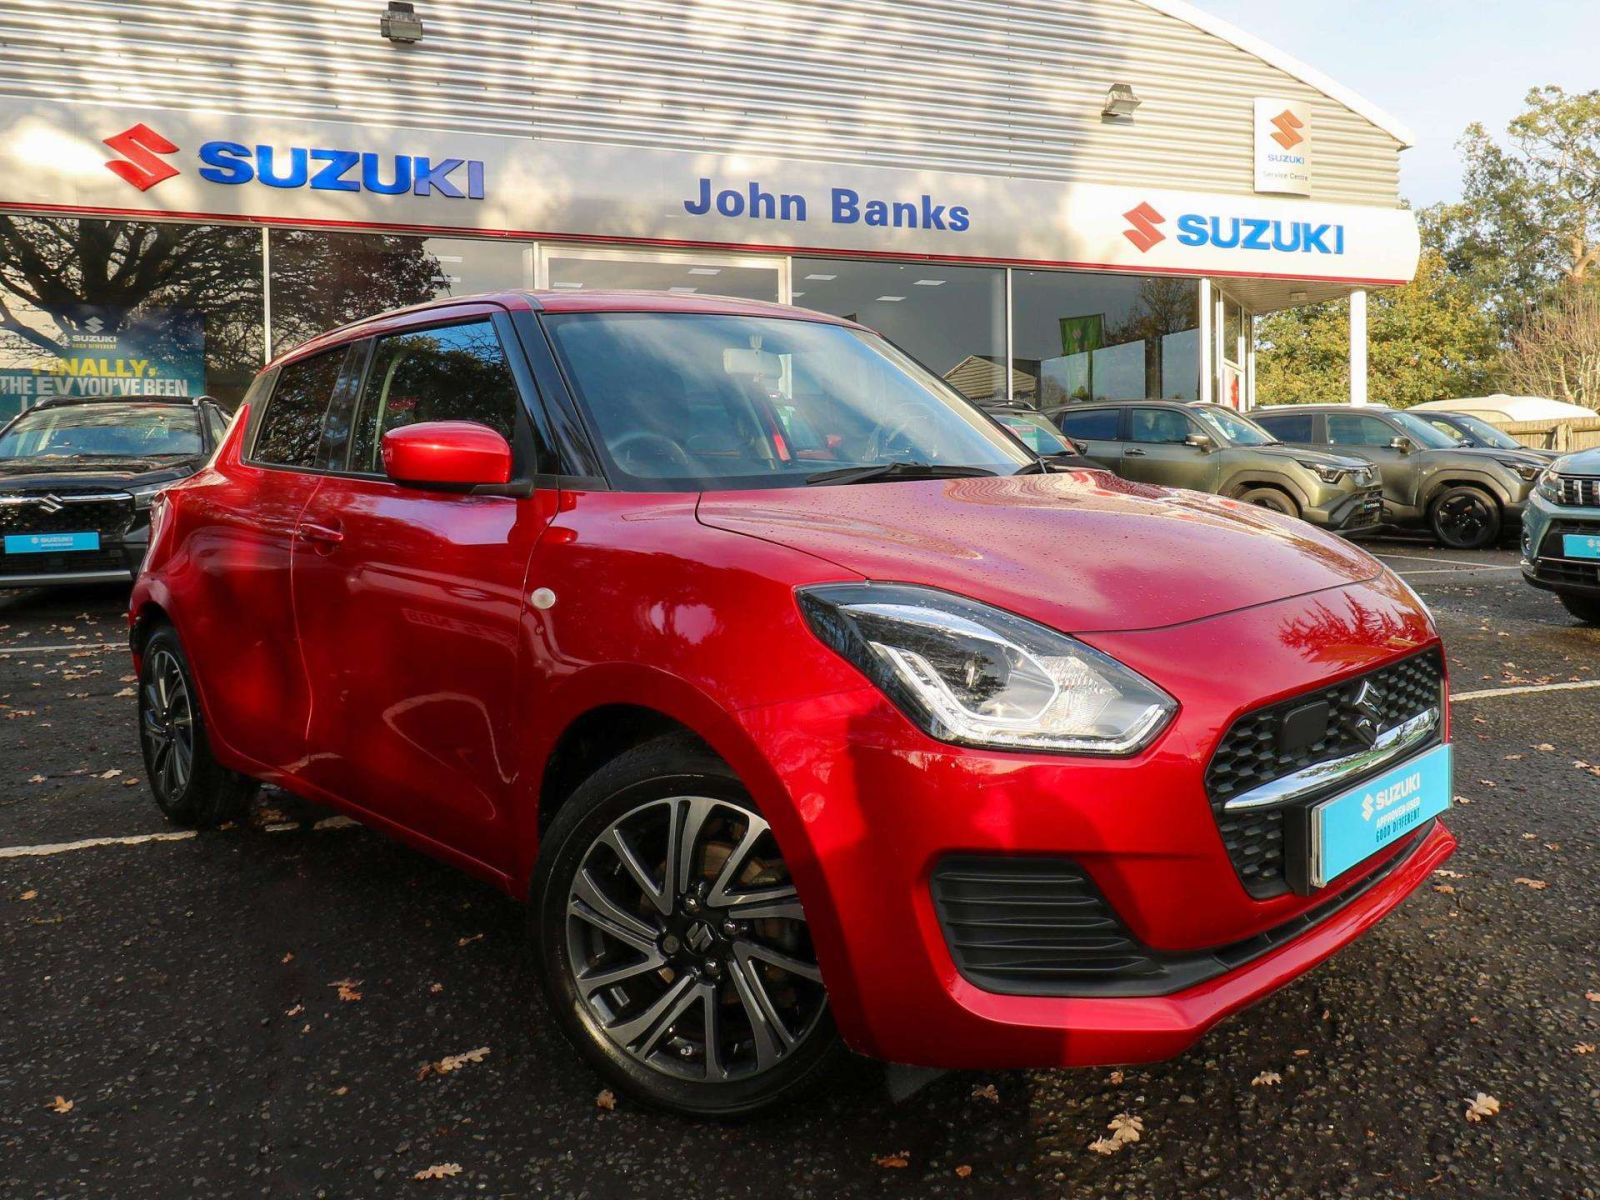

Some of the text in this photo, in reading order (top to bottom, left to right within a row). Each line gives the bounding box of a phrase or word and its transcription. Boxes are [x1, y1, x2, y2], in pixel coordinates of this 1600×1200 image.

[198, 140, 485, 200] SUZUKI
[1267, 153, 1305, 165] SUZUKI
[683, 177, 970, 232] John Banks
[1176, 212, 1345, 255] SUZUKI
[72, 335, 117, 343] SUZUKI
[0, 376, 188, 397] THE EV YOU'VE BEEN
[1375, 772, 1421, 811] SUZUKI
[1376, 824, 1391, 843] GOOD
